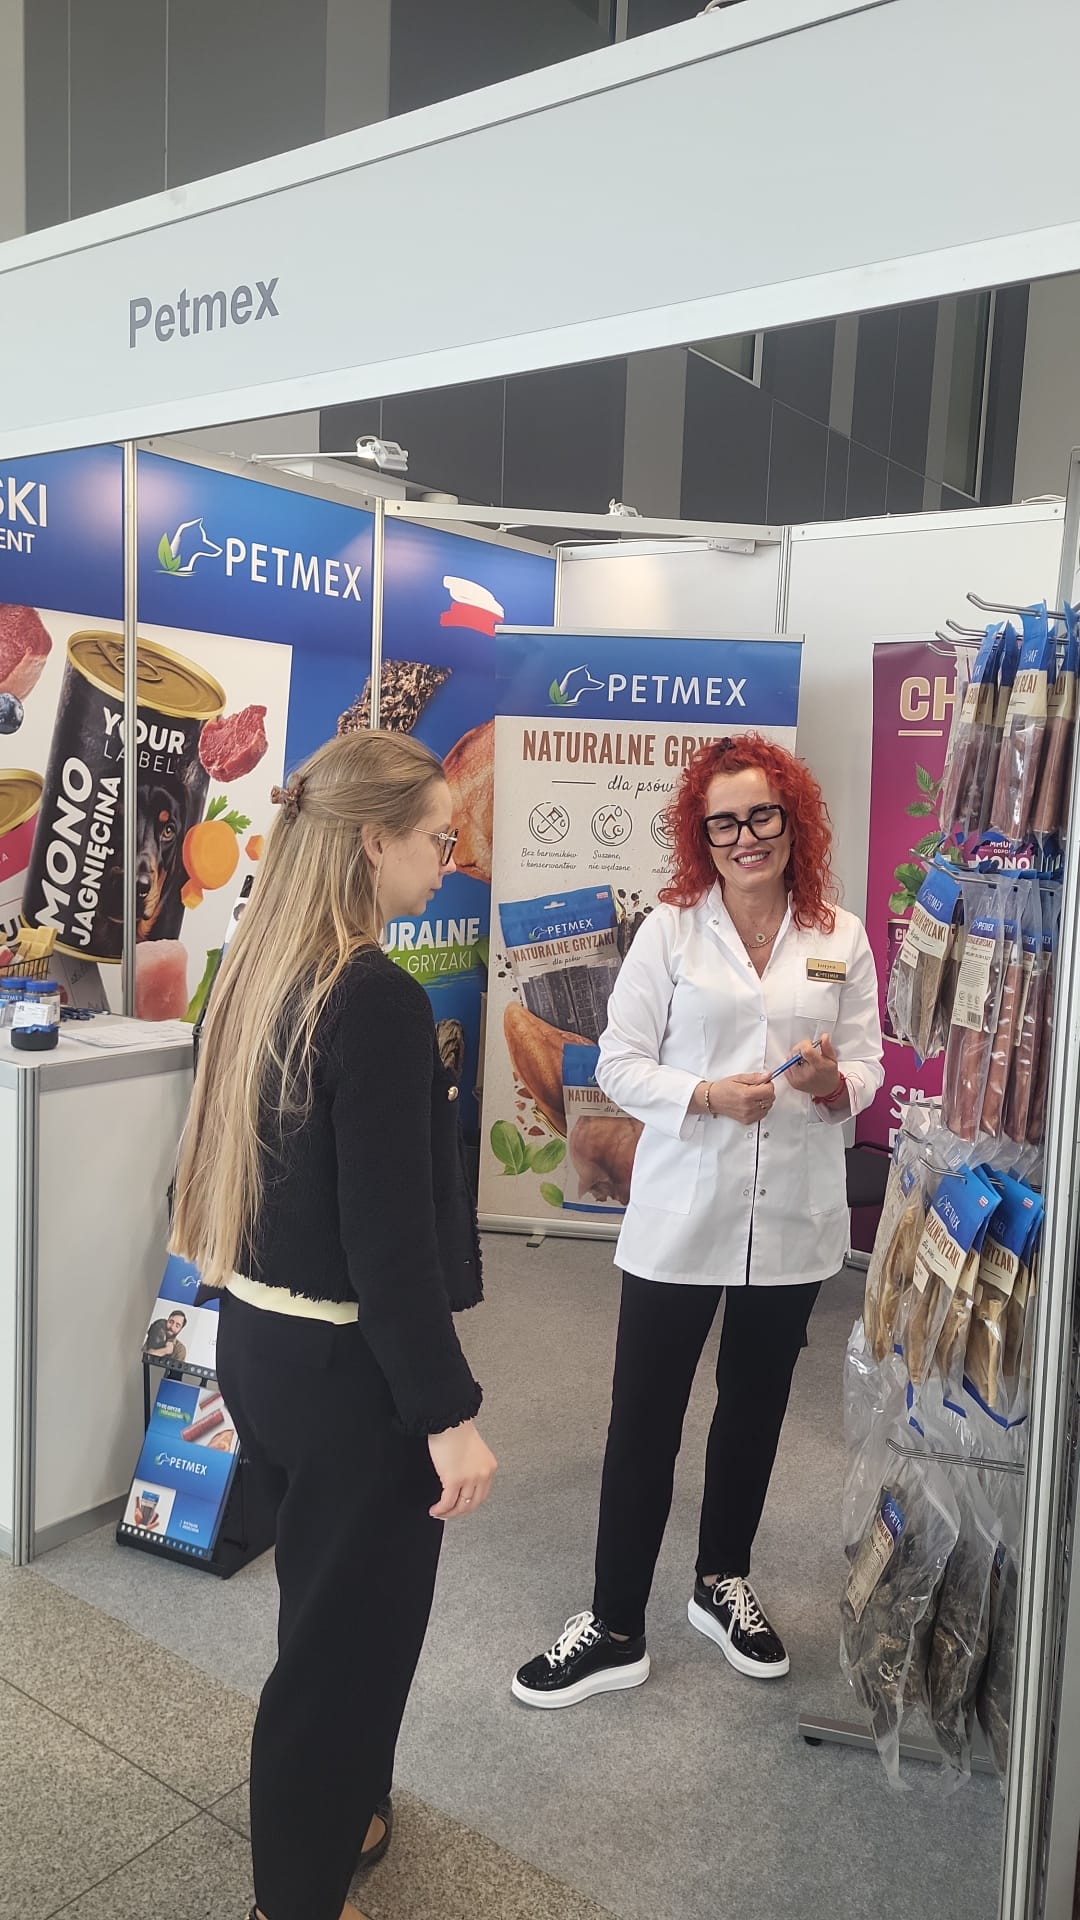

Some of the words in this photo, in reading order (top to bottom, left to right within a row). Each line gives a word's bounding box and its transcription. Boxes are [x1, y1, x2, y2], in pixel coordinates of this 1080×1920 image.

[129, 277, 279, 349] Petmex
[225, 537, 362, 602] PETMEX
[608, 673, 747, 707] PETMEX
[523, 729, 656, 766] NATURALNE
[607, 774, 632, 791] dla
[634, 778, 676, 800] psów
[35, 757, 93, 935] MONO
[71, 776, 122, 946] JAGNIĘCINA
[521, 847, 534, 858] Bez
[526, 860, 577, 870] konserwantów
[547, 918, 593, 936] PETMEX
[407, 950, 472, 974] GRYZAKI
[513, 940, 571, 964] NATURALNE
[572, 931, 616, 953] GRYZAKI
[169, 1455, 208, 1476] PETMEX
